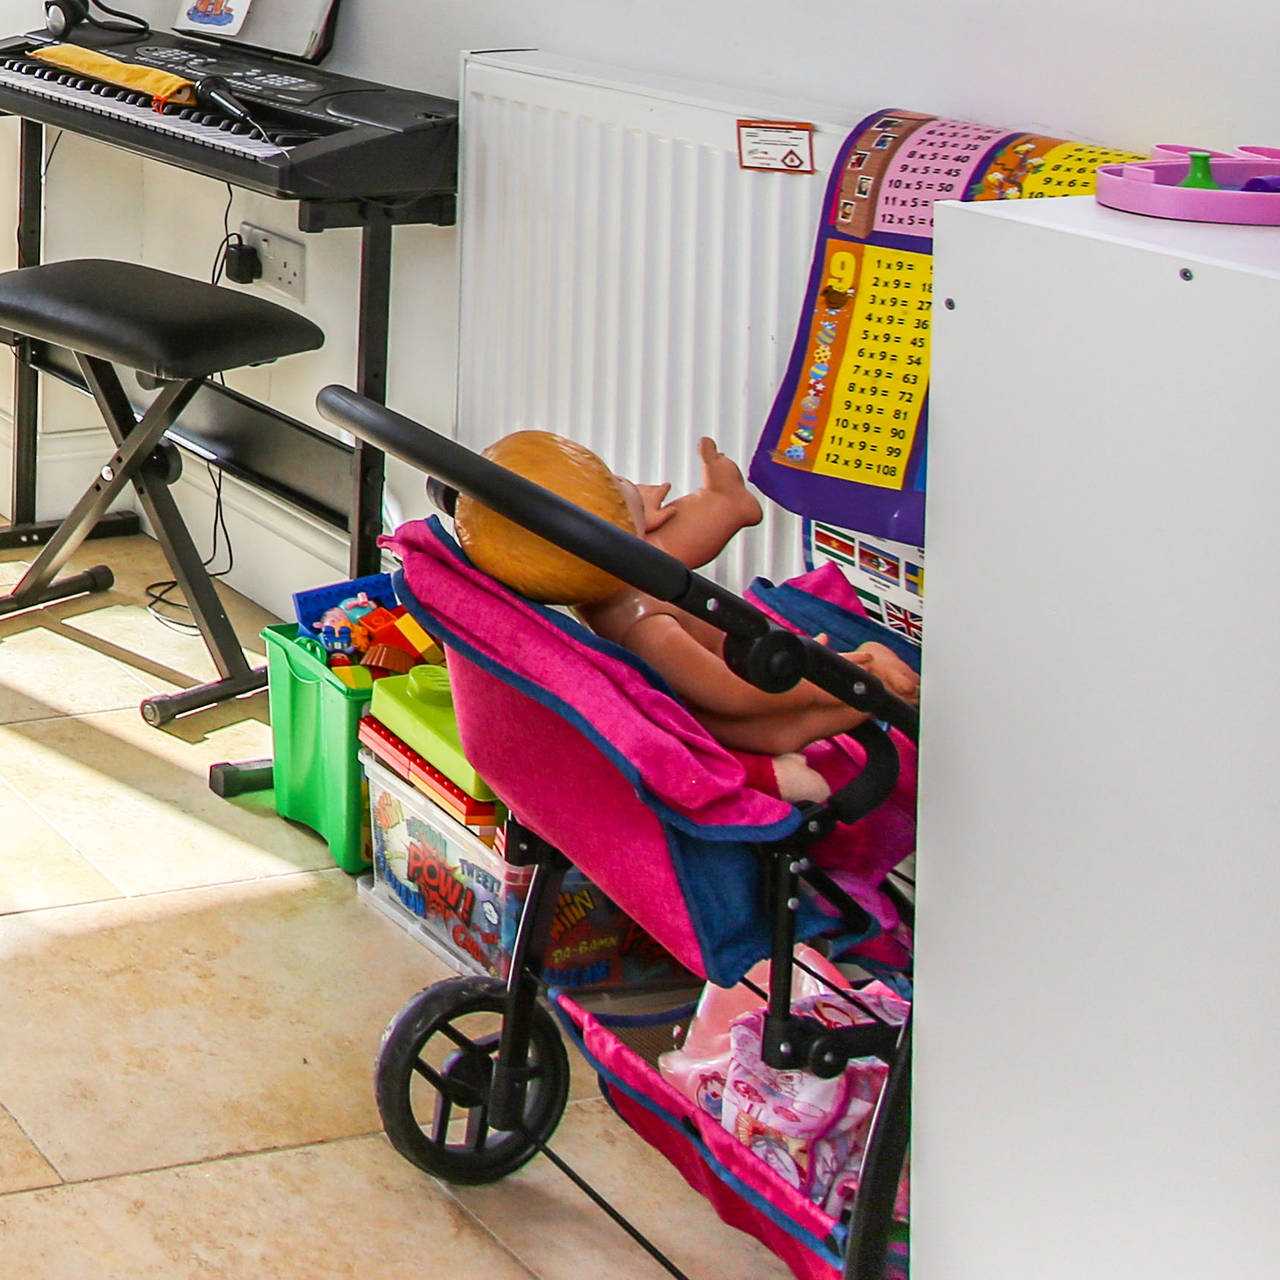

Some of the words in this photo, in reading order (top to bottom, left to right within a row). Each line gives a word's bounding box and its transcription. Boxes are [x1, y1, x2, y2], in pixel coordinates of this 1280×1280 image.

[916, 138, 928, 146] 7
[937, 140, 950, 149] 5
[961, 143, 981, 151] 35
[906, 150, 918, 159] 8
[928, 152, 940, 161] 5
[952, 155, 971, 164] 40
[899, 163, 910, 173] 9
[920, 165, 932, 175] 5
[944, 168, 962, 178] 45
[1076, 166, 1088, 174] 6
[888, 178, 903, 189] 10
[914, 180, 924, 191] 5
[936, 182, 955, 193] 50
[1042, 176, 1054, 186] 9
[1067, 178, 1078, 188] 6
[884, 195, 898, 206] 11
[910, 197, 919, 208] 5
[881, 213, 896, 225] 12
[907, 215, 916, 226] 5
[828, 251, 856, 293] 9
[876, 259, 882, 269] 1
[895, 260, 904, 271] 9
[872, 276, 880, 287] 2
[893, 278, 901, 289] 9
[869, 294, 877, 305] 3
[889, 296, 898, 307] 9
[916, 300, 932, 311] 27
[864, 312, 873, 322] 4
[886, 314, 895, 325] 9
[913, 318, 929, 330] 36
[861, 329, 870, 340] 5
[882, 332, 891, 343] 9
[909, 337, 925, 349] 45
[857, 347, 865, 358] 6
[879, 350, 887, 361] 9
[906, 354, 922, 366] 54
[853, 364, 861, 374] 7
[873, 368, 883, 379] 9
[902, 373, 918, 385] 63
[847, 382, 856, 393] 8
[869, 385, 878, 397] 9
[898, 390, 914, 403] 72
[844, 399, 852, 411] 9
[865, 403, 874, 415] 9
[892, 408, 908, 421] 81
[835, 417, 849, 429] 10
[862, 422, 871, 433] 9
[890, 427, 906, 440] 90
[830, 435, 843, 446] 11
[858, 440, 867, 451] 9
[886, 445, 902, 458] 99
[825, 452, 840, 465] 12
[853, 458, 863, 469] 9
[876, 463, 897, 477] 108
[407, 841, 476, 927] POW!
